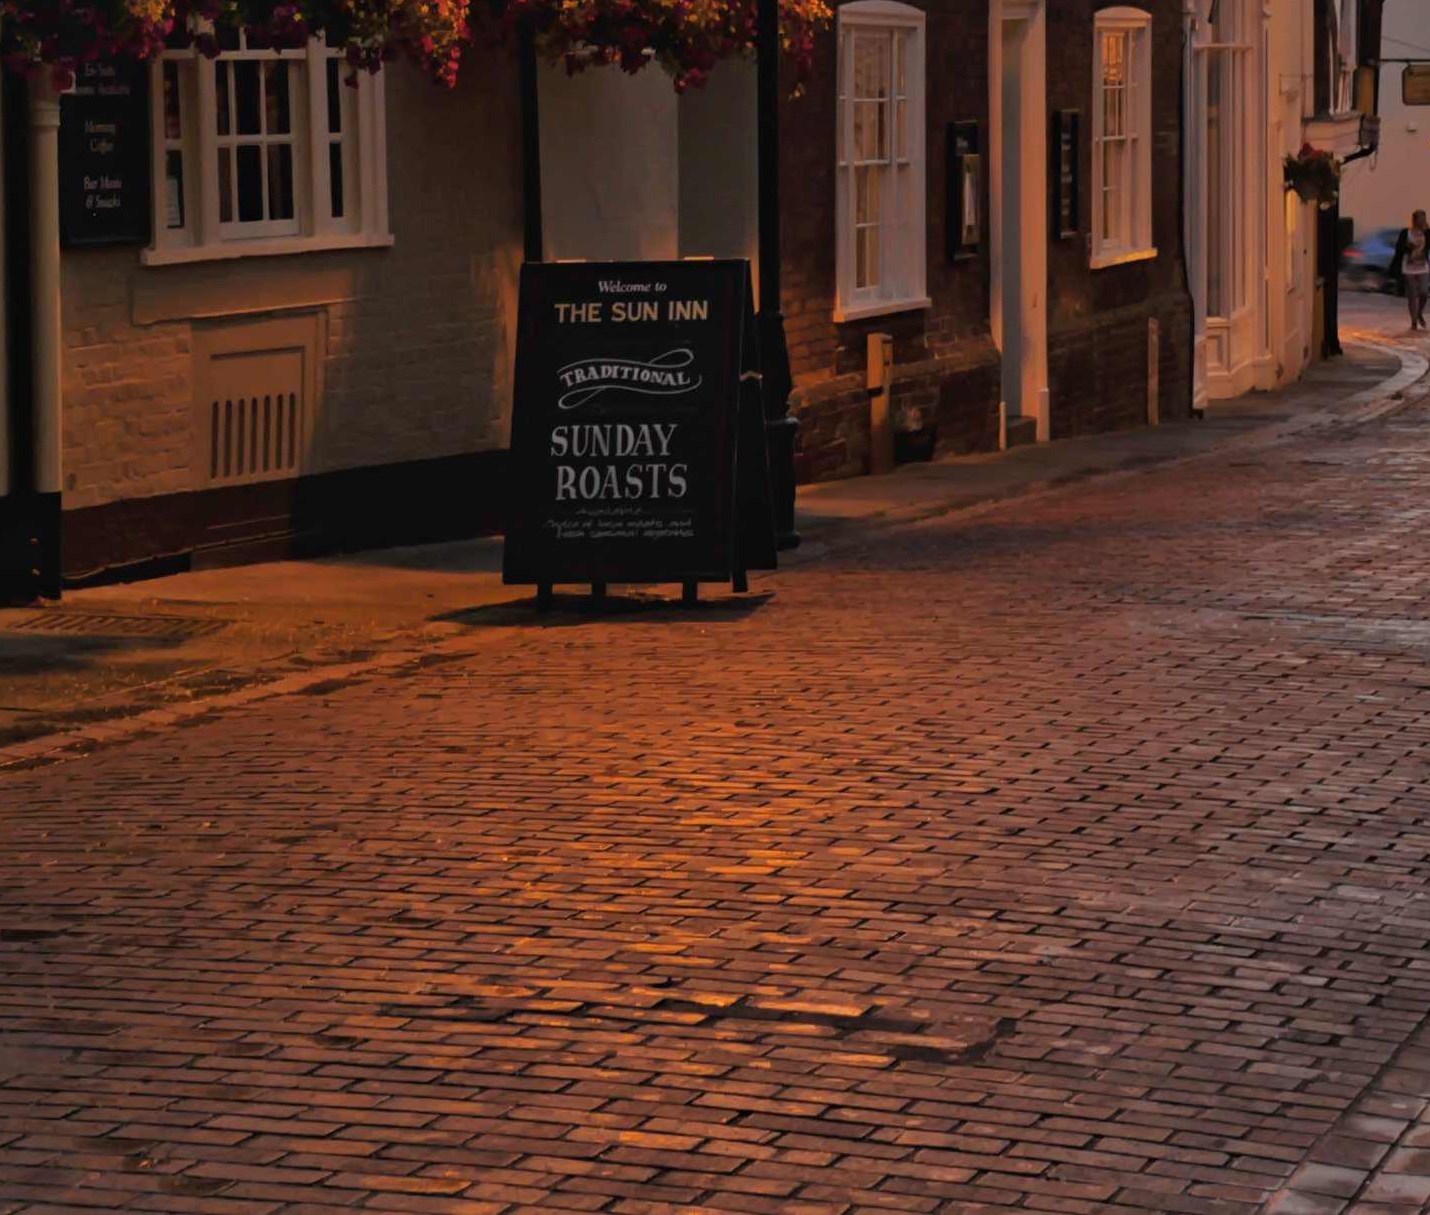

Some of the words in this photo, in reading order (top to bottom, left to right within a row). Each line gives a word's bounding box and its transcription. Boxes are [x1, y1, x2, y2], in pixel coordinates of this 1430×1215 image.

[597, 280, 650, 293] Welcome
[655, 281, 667, 293] to
[554, 302, 602, 323] THE
[610, 301, 659, 322] SUN
[668, 300, 709, 321] INN
[559, 365, 691, 387] TRADITIONAL
[550, 423, 678, 458] SUNDAY
[555, 463, 688, 501] ROASTS
